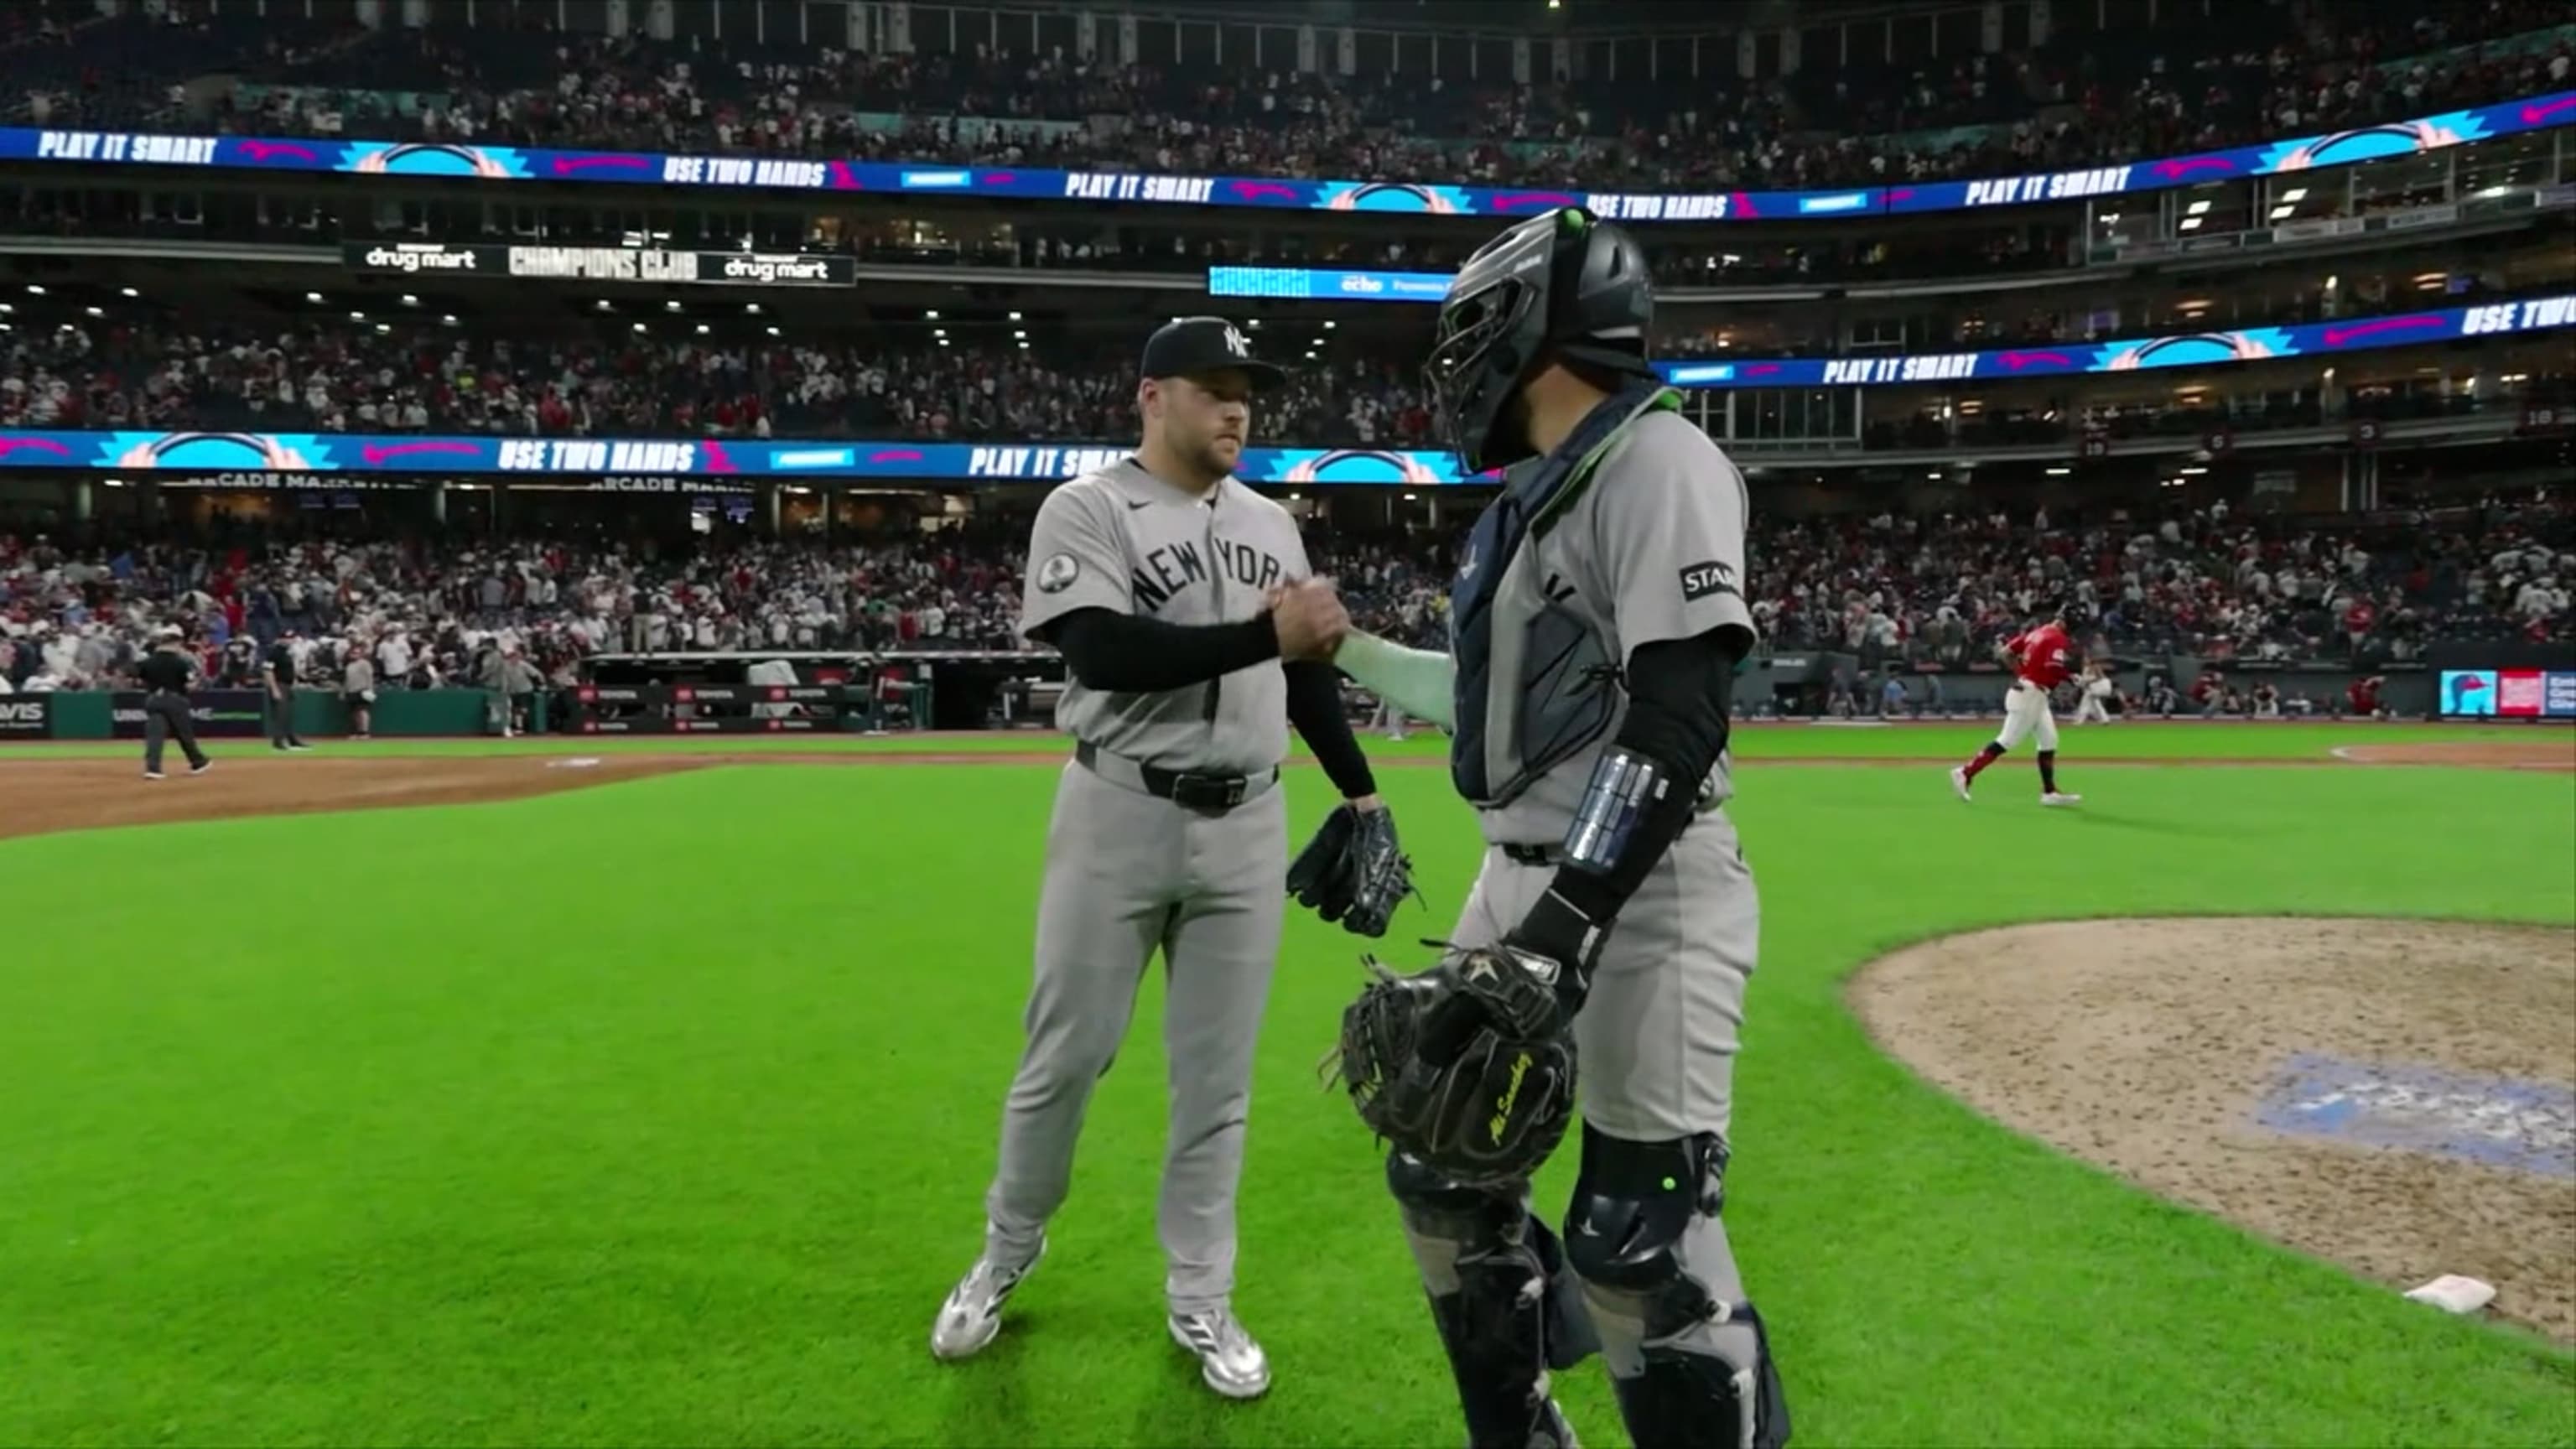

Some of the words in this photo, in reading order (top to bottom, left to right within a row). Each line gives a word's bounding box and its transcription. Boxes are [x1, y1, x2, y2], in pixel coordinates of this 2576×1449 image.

[38, 131, 99, 158] PLAY
[102, 133, 127, 160] IT
[131, 135, 217, 164] SMART
[663, 157, 704, 183] USE
[707, 158, 752, 184] TWO
[755, 160, 826, 187] HANDS
[1965, 176, 2020, 205] PLAY
[2022, 173, 2049, 201] IT
[2049, 167, 2132, 198] SMART
[1065, 173, 1116, 198] PLAY
[1118, 175, 1140, 200] IT
[1142, 176, 1214, 202] SMART
[1587, 194, 1621, 218] USE
[1622, 195, 1662, 219] TWO
[1663, 195, 1727, 220] HANDS
[366, 247, 418, 272] drug
[422, 251, 475, 268] mart
[510, 247, 635, 278] CHAMPIONS
[641, 251, 697, 279] CLUB
[724, 258, 775, 281] drug
[776, 261, 828, 279] mart
[1342, 275, 1383, 292] echo
[2462, 303, 2517, 335] USE
[1822, 361, 1875, 384] PLAY
[1876, 359, 1900, 383] IT
[1901, 354, 1979, 382] SMART
[498, 439, 548, 470] USE
[550, 441, 607, 471] TWO
[609, 443, 695, 471] HANDS
[969, 448, 1030, 475] PLAY
[1032, 449, 1060, 476] IT
[1131, 540, 1207, 612] NEW
[1214, 537, 1280, 589] YOR
